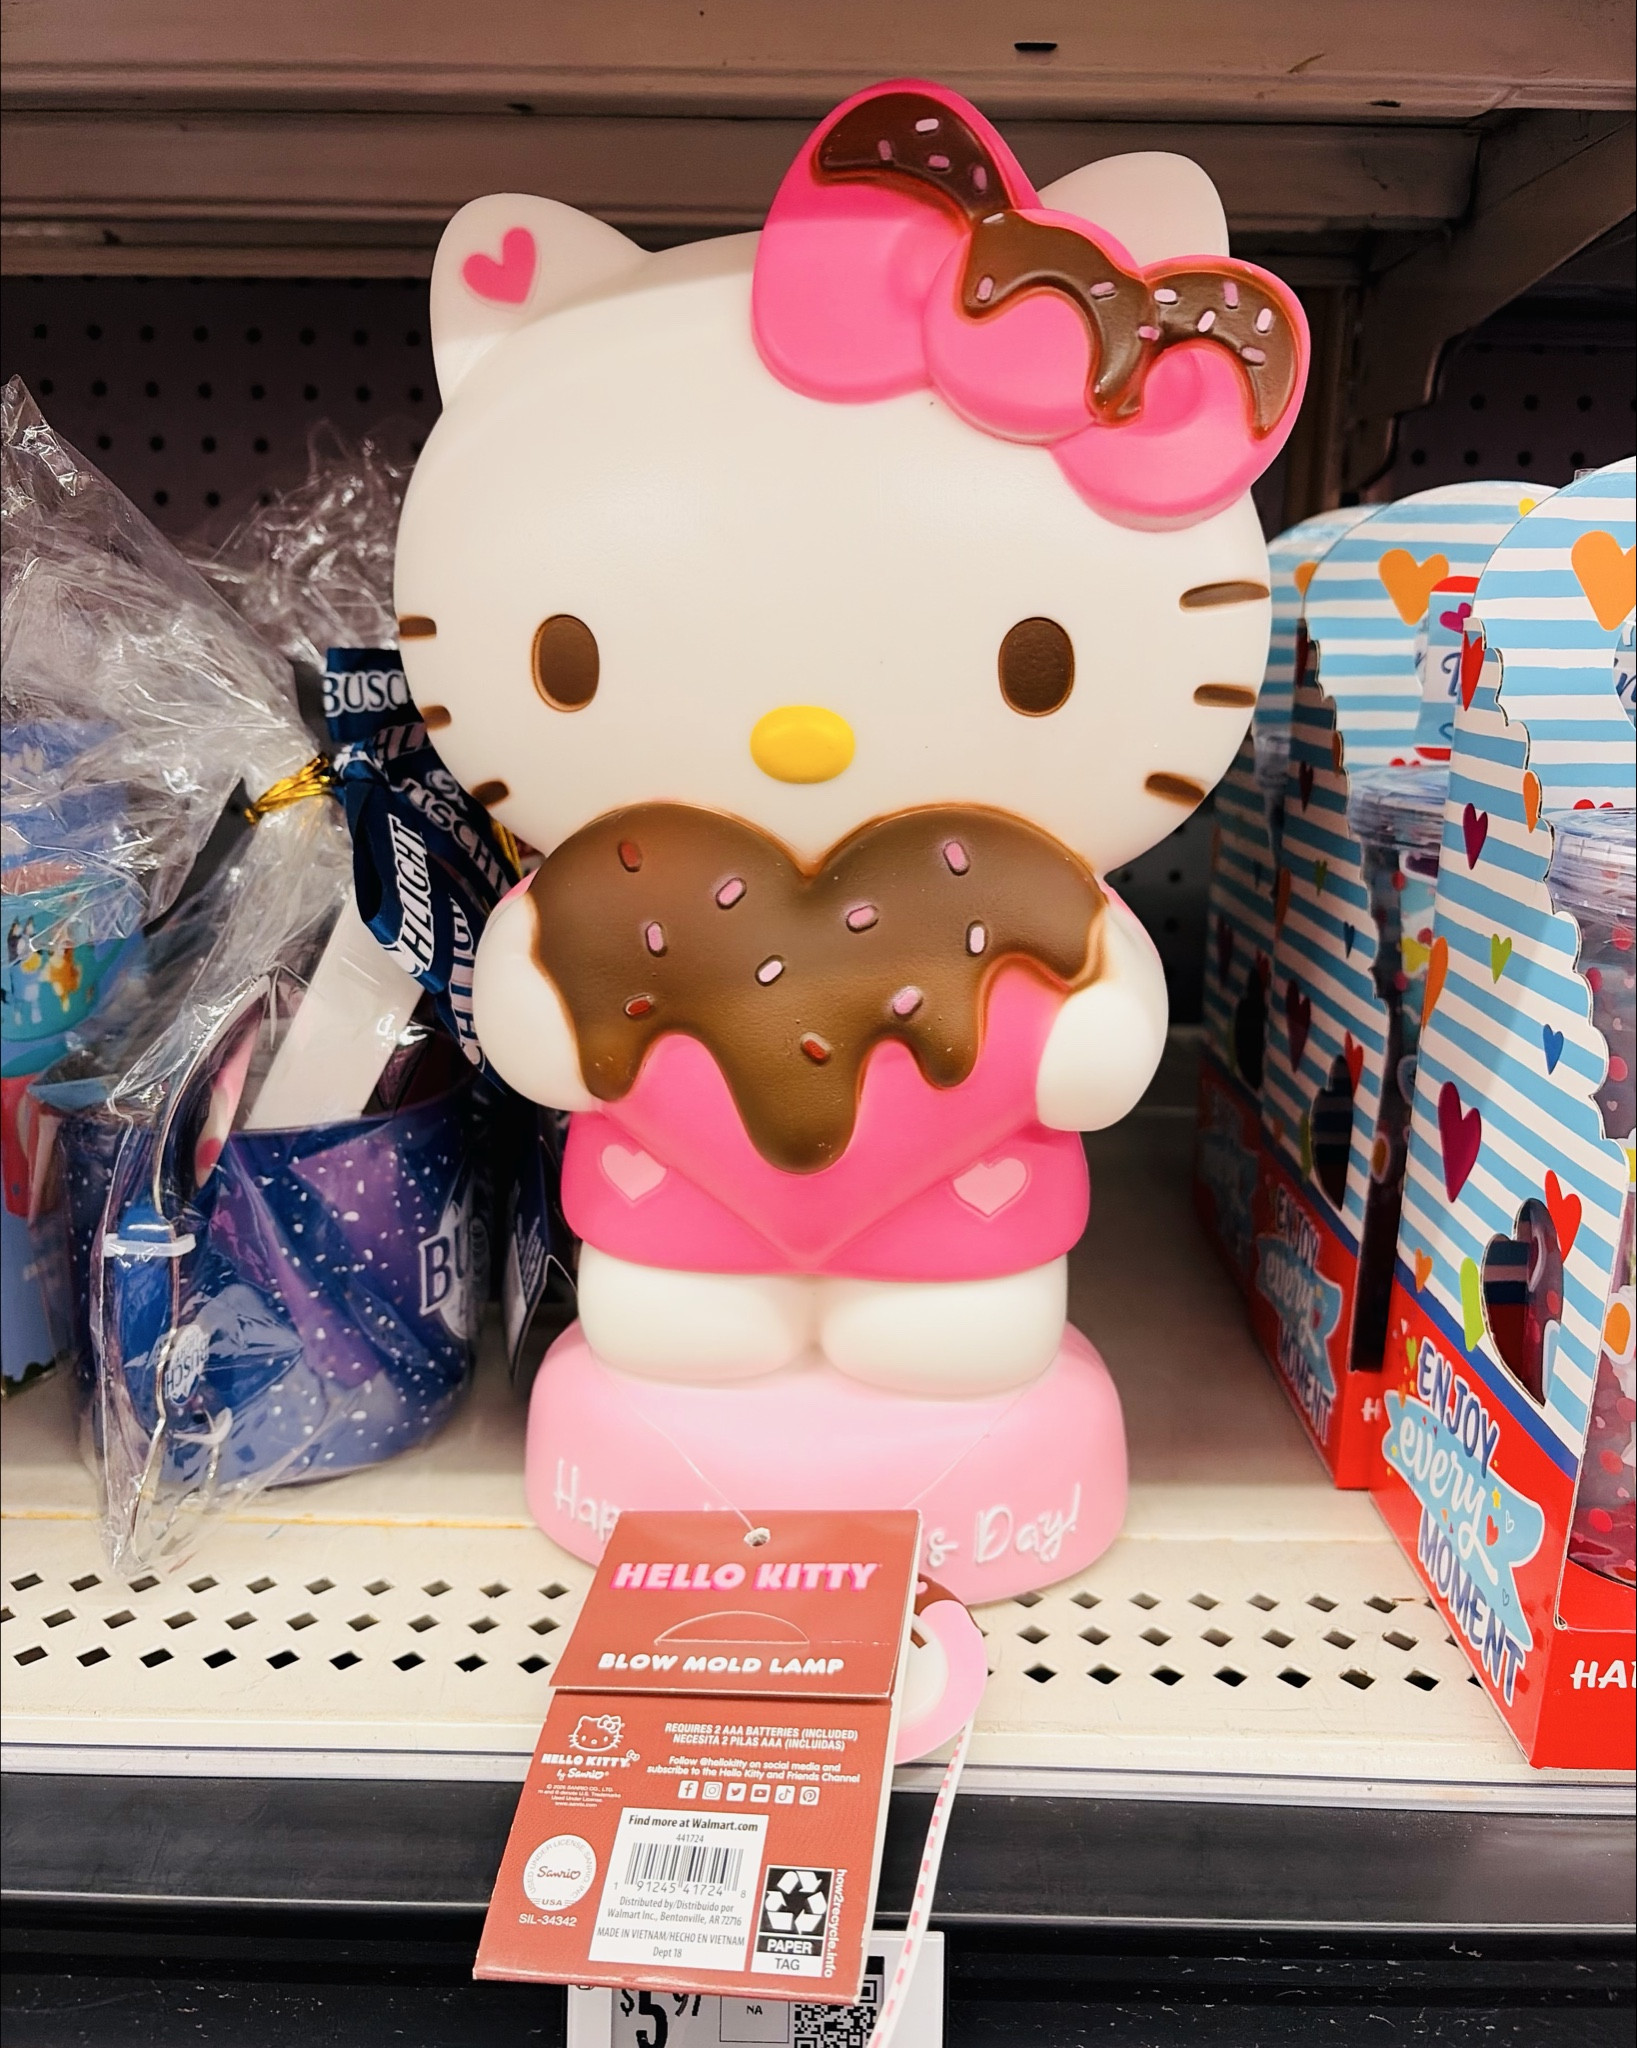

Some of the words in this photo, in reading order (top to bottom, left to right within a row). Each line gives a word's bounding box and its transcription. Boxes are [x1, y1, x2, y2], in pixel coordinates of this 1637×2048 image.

[323, 669, 409, 718] BUSC
[1416, 1335, 1499, 1479] ENJOY
[1400, 1414, 1498, 1585] every
[554, 1457, 621, 1543] Hap
[974, 1480, 1081, 1563] Day!
[610, 1562, 745, 1591] HELLO
[752, 1562, 878, 1592] KITTY
[1417, 1503, 1527, 1707] MOMENT
[598, 1653, 678, 1671] BLOW
[682, 1656, 762, 1673] MOLD
[769, 1658, 844, 1675] LAMP
[1570, 1659, 1636, 1690] HA
[664, 1723, 713, 1734] REQUIRES
[714, 1725, 720, 1734] 2
[722, 1726, 744, 1736] AAA
[745, 1727, 800, 1738] BATTERIES
[801, 1728, 858, 1740] (INCLUDED)
[673, 1734, 719, 1745] NECESITA
[721, 1736, 728, 1745] 2
[730, 1737, 759, 1747] PILAS
[760, 1738, 782, 1748] AAA
[784, 1739, 845, 1751] (INCLUIDAS)
[541, 1753, 583, 1766] HELLO
[586, 1756, 630, 1768] KITTY
[669, 1756, 697, 1766] Follow
[699, 1757, 748, 1769] @hellokitty
[763, 1760, 789, 1770] social
[791, 1762, 820, 1771] media
[822, 1763, 841, 1772] and
[557, 1769, 566, 1781] by
[647, 1765, 689, 1775] subscribe
[691, 1767, 700, 1775] to
[702, 1767, 717, 1776] the
[719, 1768, 742, 1777] Hello
[744, 1769, 764, 1780] Kitty
[766, 1770, 784, 1779] and
[787, 1771, 820, 1781] Friends
[821, 1773, 860, 1783] Channel
[628, 1814, 649, 1826] Find
[651, 1818, 678, 1828] more
[679, 1818, 690, 1828] at
[692, 1818, 758, 1832] Walmart.com
[675, 1834, 704, 1843] 441724
[537, 1866, 581, 1880] Sanrio
[613, 1882, 618, 1890] 1
[636, 1881, 676, 1893] 91245
[682, 1885, 723, 1896] 41724
[740, 1890, 746, 1898] 8
[619, 1896, 662, 1908] Distributed
[664, 1898, 719, 1911] by/Distribuido
[720, 1905, 734, 1913] por
[518, 1913, 578, 1927] SIL-34342
[607, 1908, 640, 1919] Walmart
[642, 1910, 658, 1921] Inc.,
[660, 1912, 707, 1925] Bentonville,
[708, 1916, 719, 1924] AR
[823, 1868, 848, 1978] how2recycle.info
[597, 1927, 620, 1938] MADE
[621, 1929, 630, 1938] IN
[631, 1929, 696, 1943] VIETNAM/HECHO
[697, 1934, 708, 1943] EN
[709, 1934, 745, 1946] VIETNAM
[653, 1946, 671, 1959] Dept
[673, 1948, 682, 1957] 18
[766, 1938, 813, 1954] PAPER
[774, 1957, 800, 1970] TAG
[746, 2005, 763, 2015] NA
